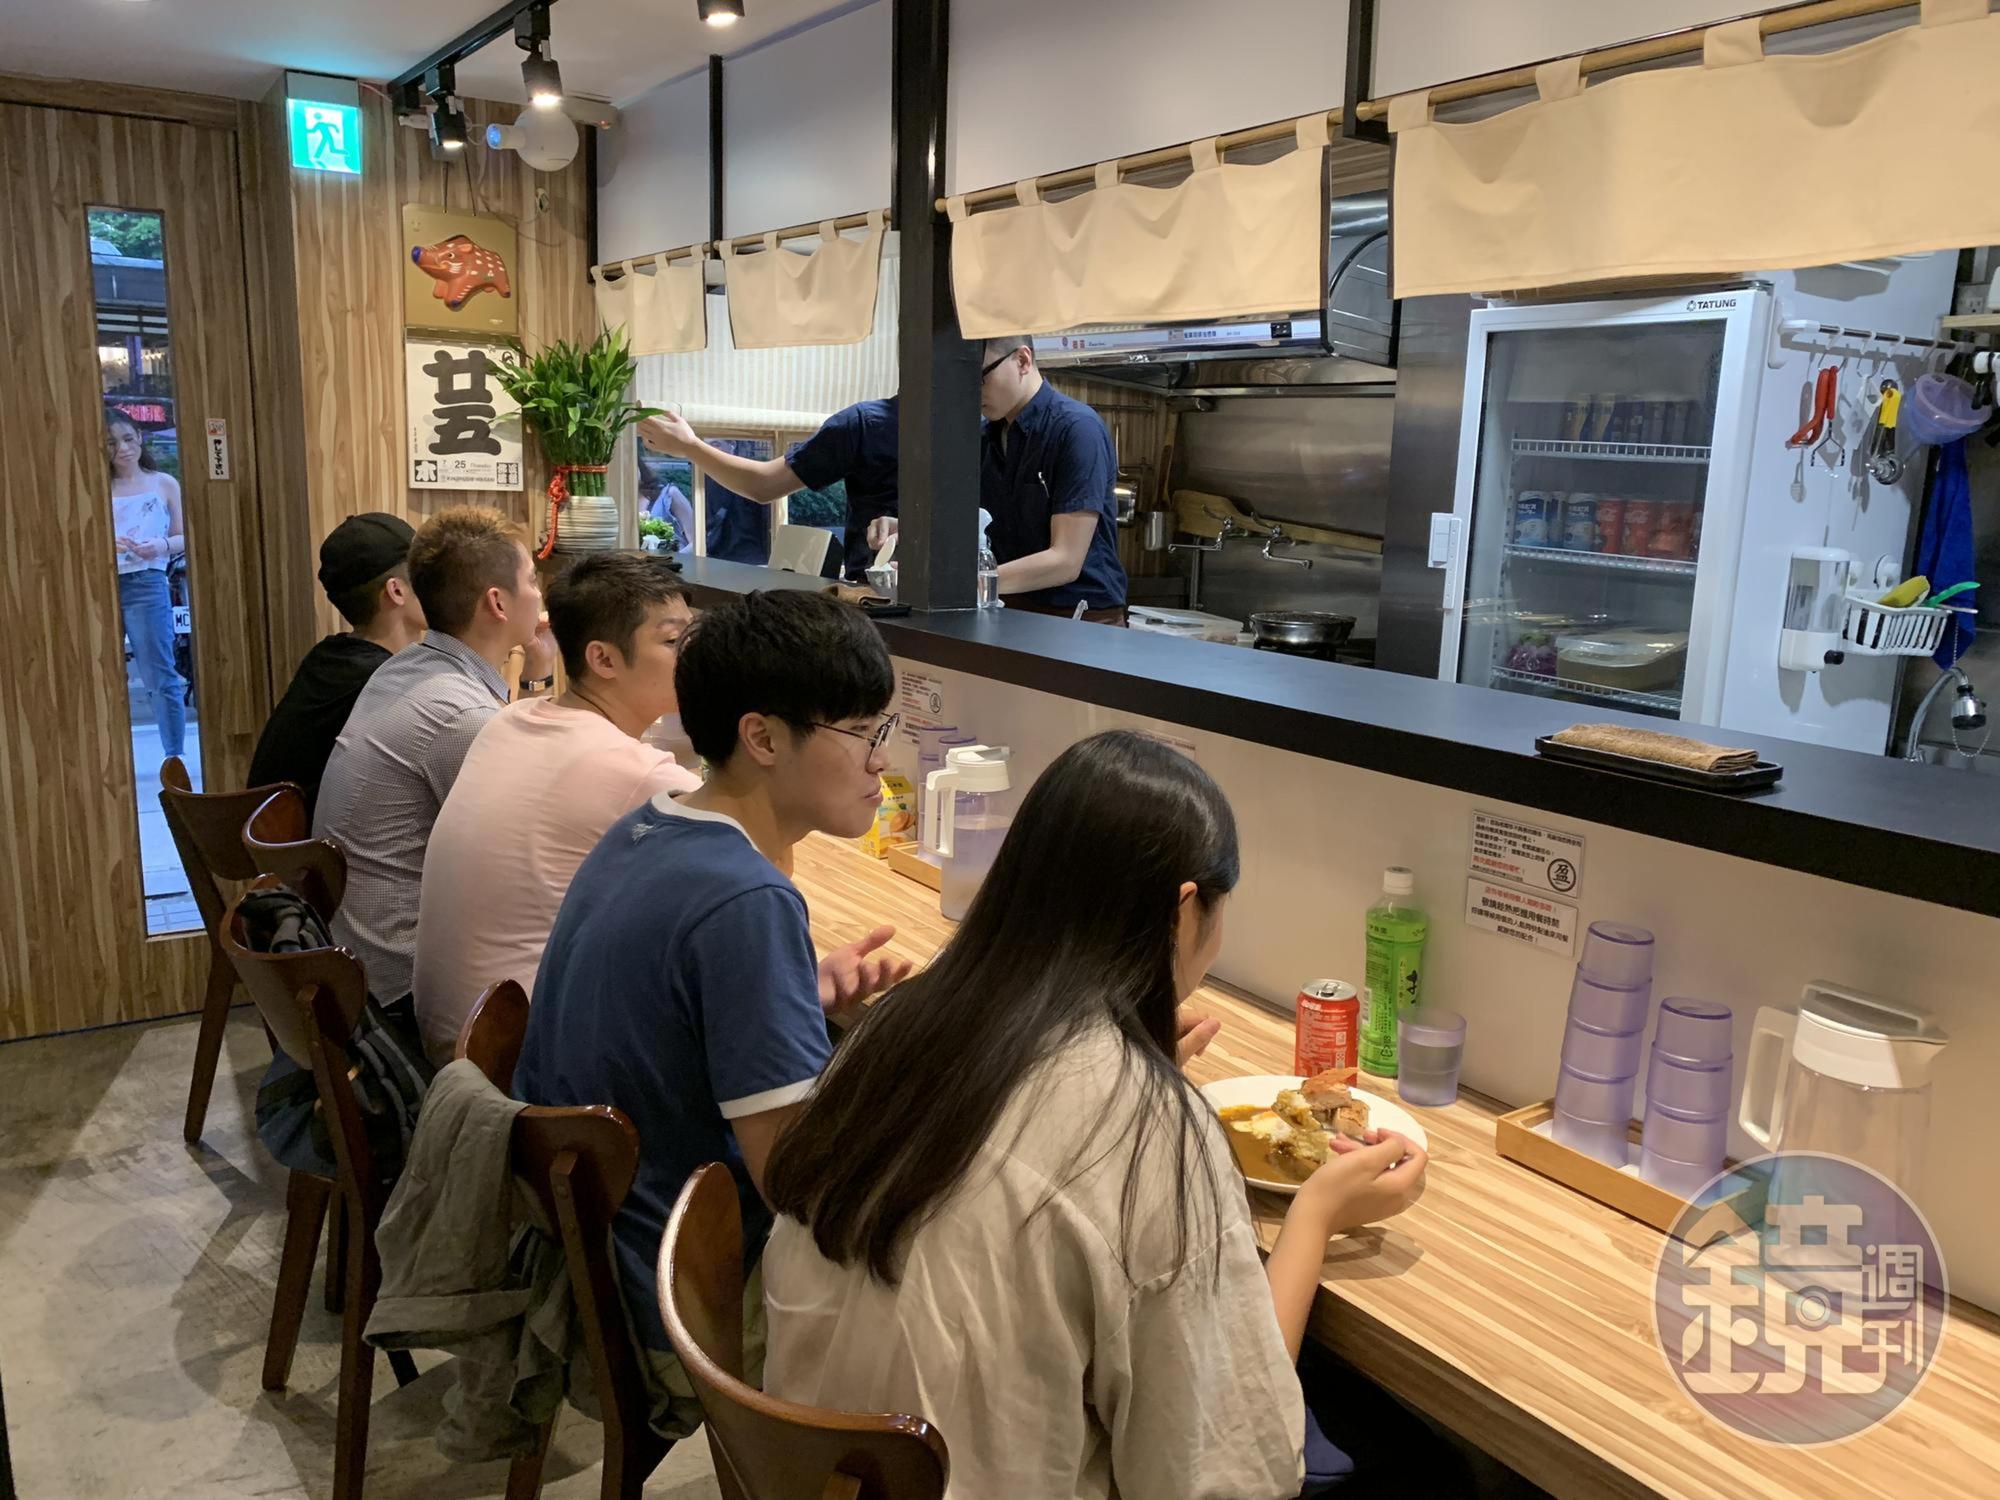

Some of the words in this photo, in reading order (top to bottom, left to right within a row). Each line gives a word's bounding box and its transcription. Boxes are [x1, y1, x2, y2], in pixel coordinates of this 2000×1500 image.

[1697, 299, 1736, 309] TATUNG
[454, 460, 466, 469] 25
[415, 460, 437, 482] 木
